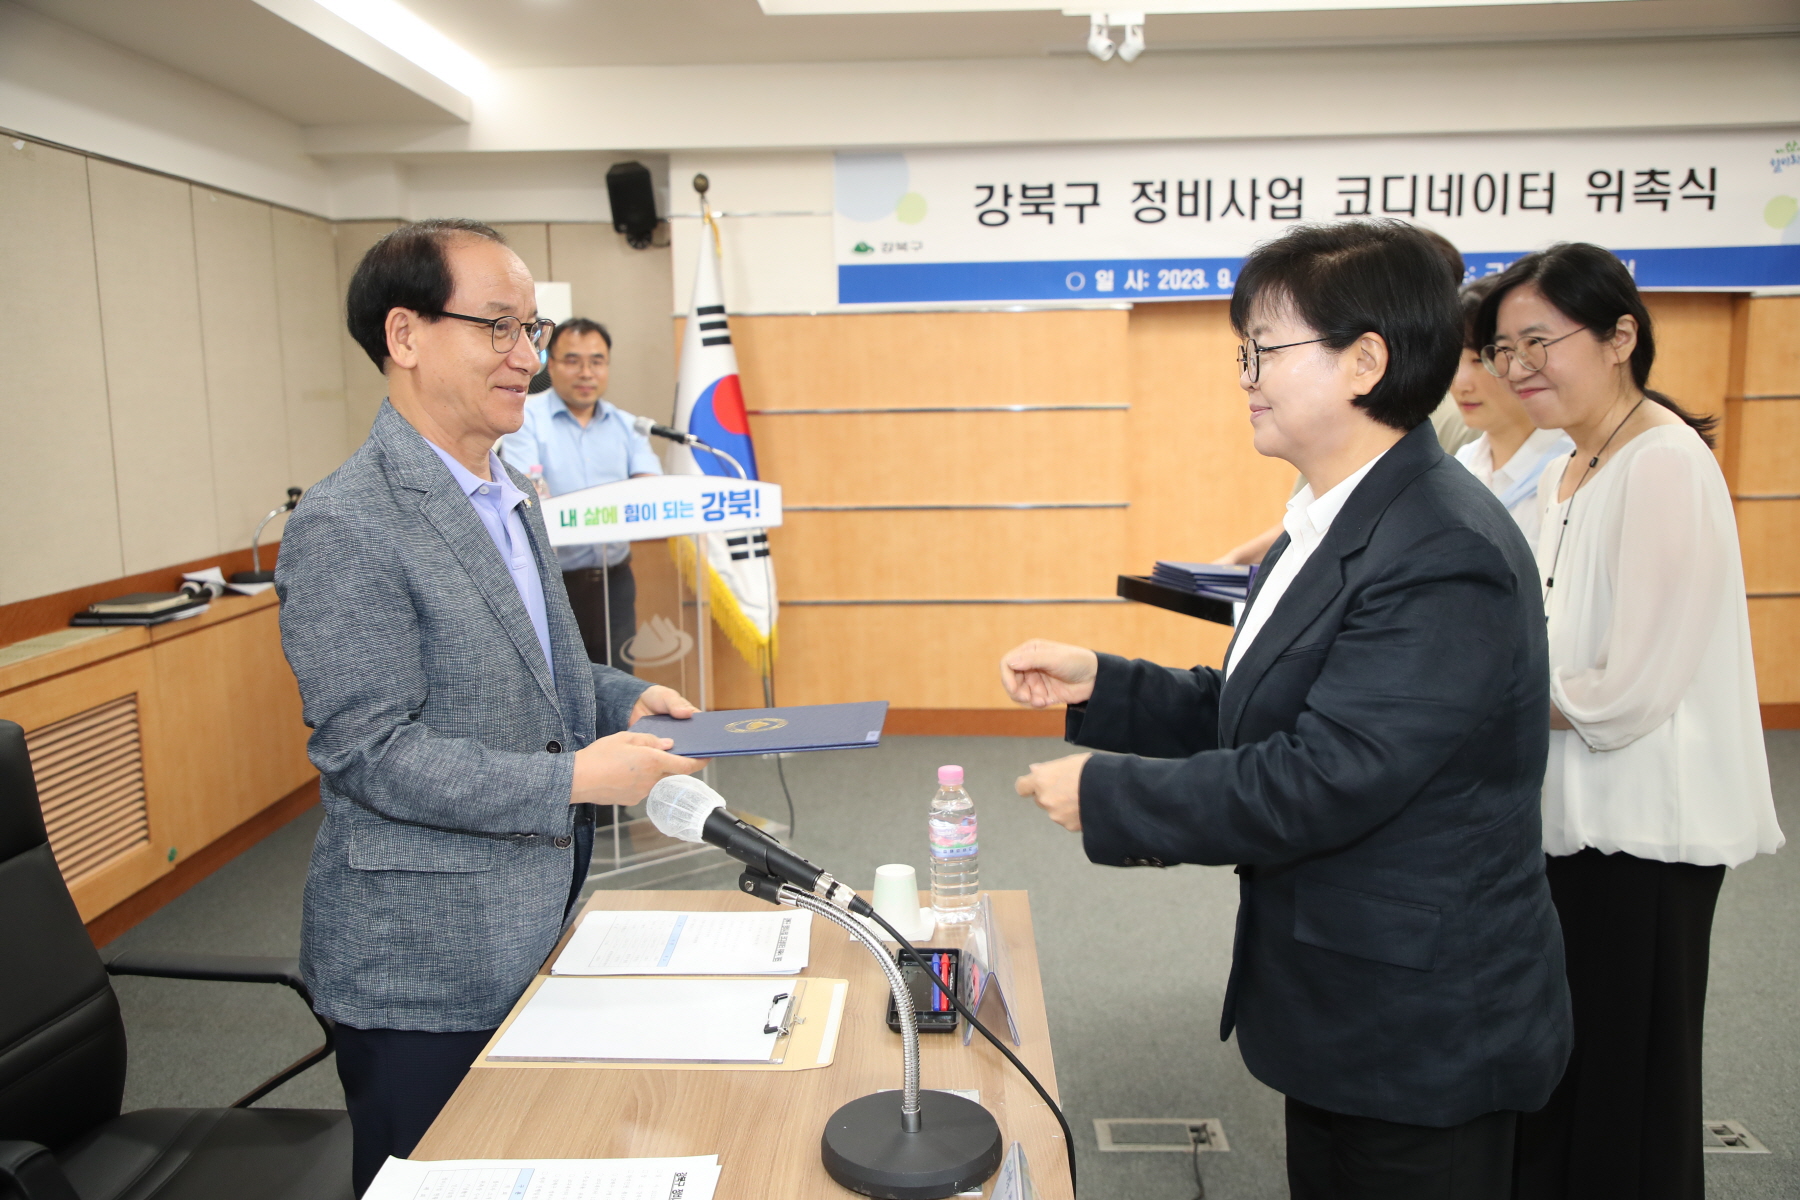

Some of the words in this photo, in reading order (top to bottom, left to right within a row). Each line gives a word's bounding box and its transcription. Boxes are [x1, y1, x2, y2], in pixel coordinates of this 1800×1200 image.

[974, 181, 1101, 227] 강북구
[1131, 176, 1304, 224] 정비사업
[1335, 172, 1555, 218] 코디네이터
[1587, 167, 1717, 213] 위촉식
[1095, 269, 1114, 291] 일
[1157, 268, 1209, 290] 2023.
[1217, 268, 1234, 289] 9.
[560, 509, 577, 527] 내
[584, 505, 618, 526] 삶에
[624, 502, 657, 523] 힘이
[663, 500, 694, 520] 되는
[702, 489, 760, 522] 강북!
